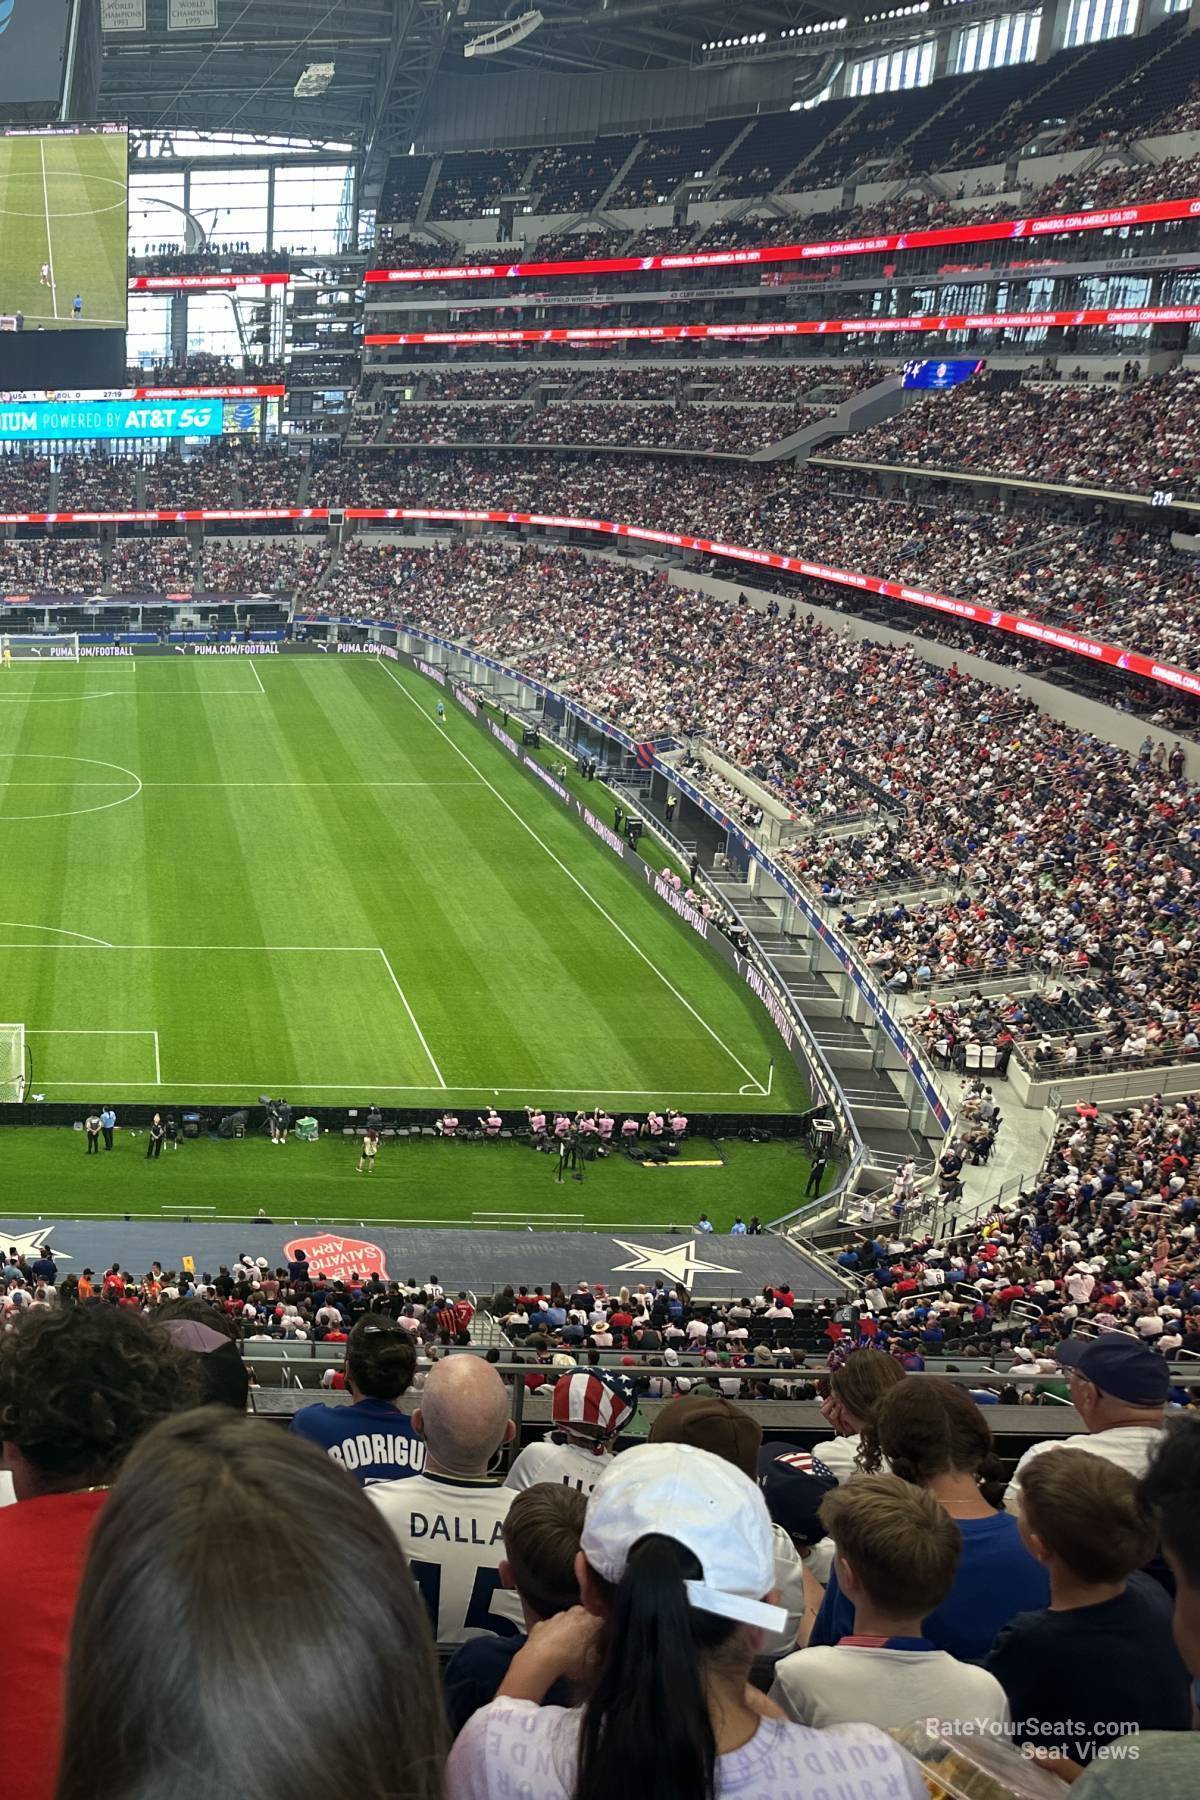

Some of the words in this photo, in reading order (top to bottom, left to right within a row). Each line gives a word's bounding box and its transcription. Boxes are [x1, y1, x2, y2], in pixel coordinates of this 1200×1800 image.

[171, 9, 213, 17] CHAMPIONS
[43, 413, 101, 428] POWERED
[107, 412, 120, 427] BY
[125, 410, 176, 429] AT&T
[178, 408, 213, 427] 5G
[195, 644, 279, 655] PUMA.COM/FOOTBALL
[654, 878, 708, 940] PUMA.COM/FOOTBALL
[746, 965, 793, 1051] PUMA.COM/FOOTBALL
[303, 1240, 344, 1258] ARMY
[308, 1247, 377, 1272] SALVATIO
[334, 1263, 370, 1278] THE
